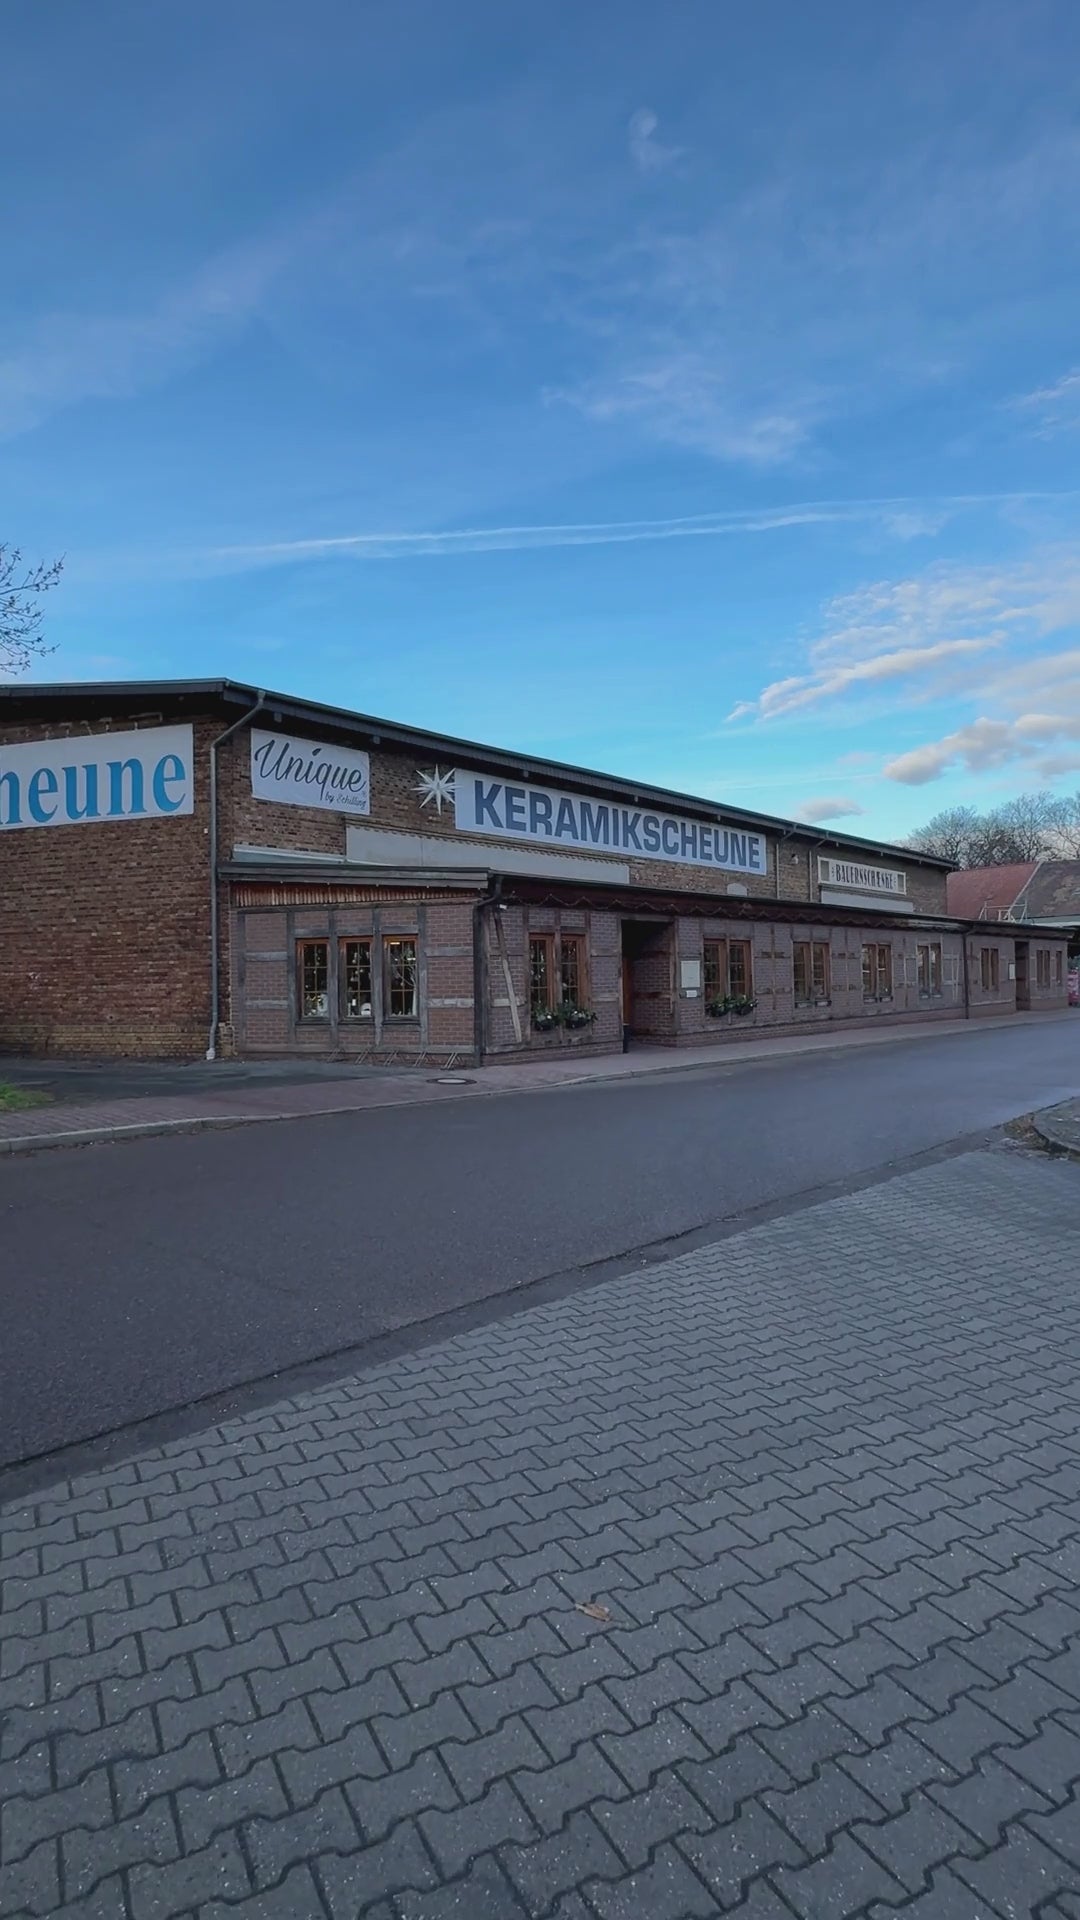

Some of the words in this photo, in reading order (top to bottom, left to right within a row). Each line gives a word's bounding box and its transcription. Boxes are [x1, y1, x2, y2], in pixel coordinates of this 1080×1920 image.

[254, 739, 367, 801] Unique
[325, 791, 335, 805] by
[474, 780, 761, 869] KERAMIKSCHEUNE
